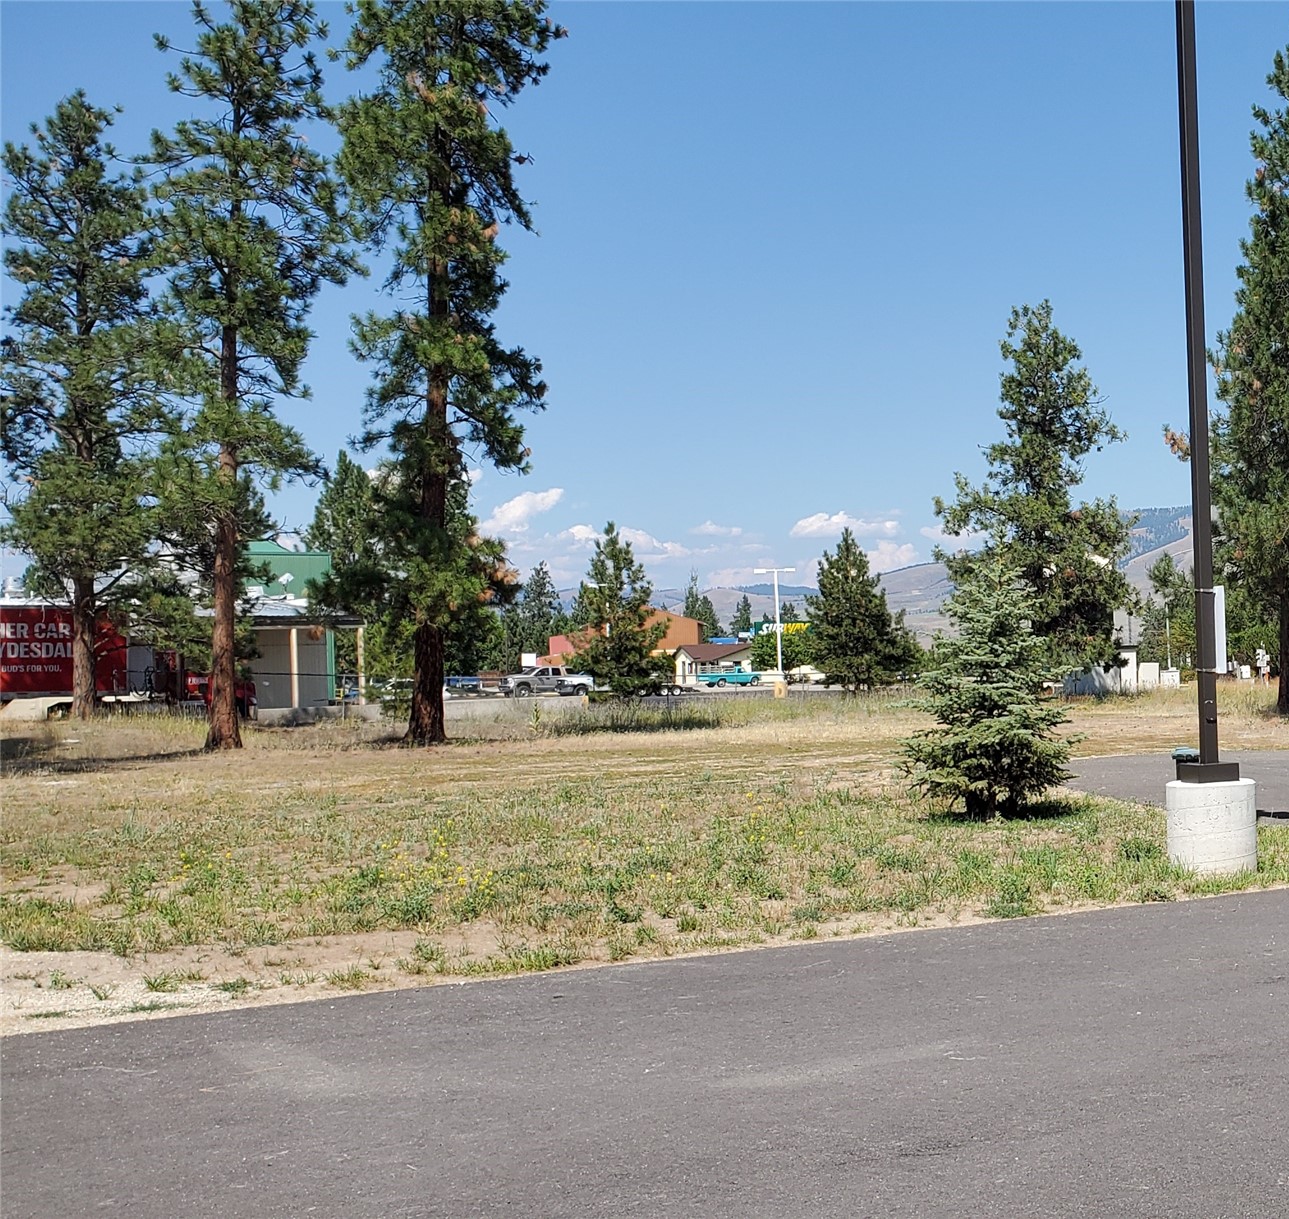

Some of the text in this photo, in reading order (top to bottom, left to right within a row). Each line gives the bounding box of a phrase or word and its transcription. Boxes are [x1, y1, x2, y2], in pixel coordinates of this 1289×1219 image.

[34, 622, 71, 638] CAR
[758, 623, 811, 635] SUBWAY
[0, 642, 73, 658] YDESDAL
[1, 664, 62, 673] BUD'S FOR YOU.
